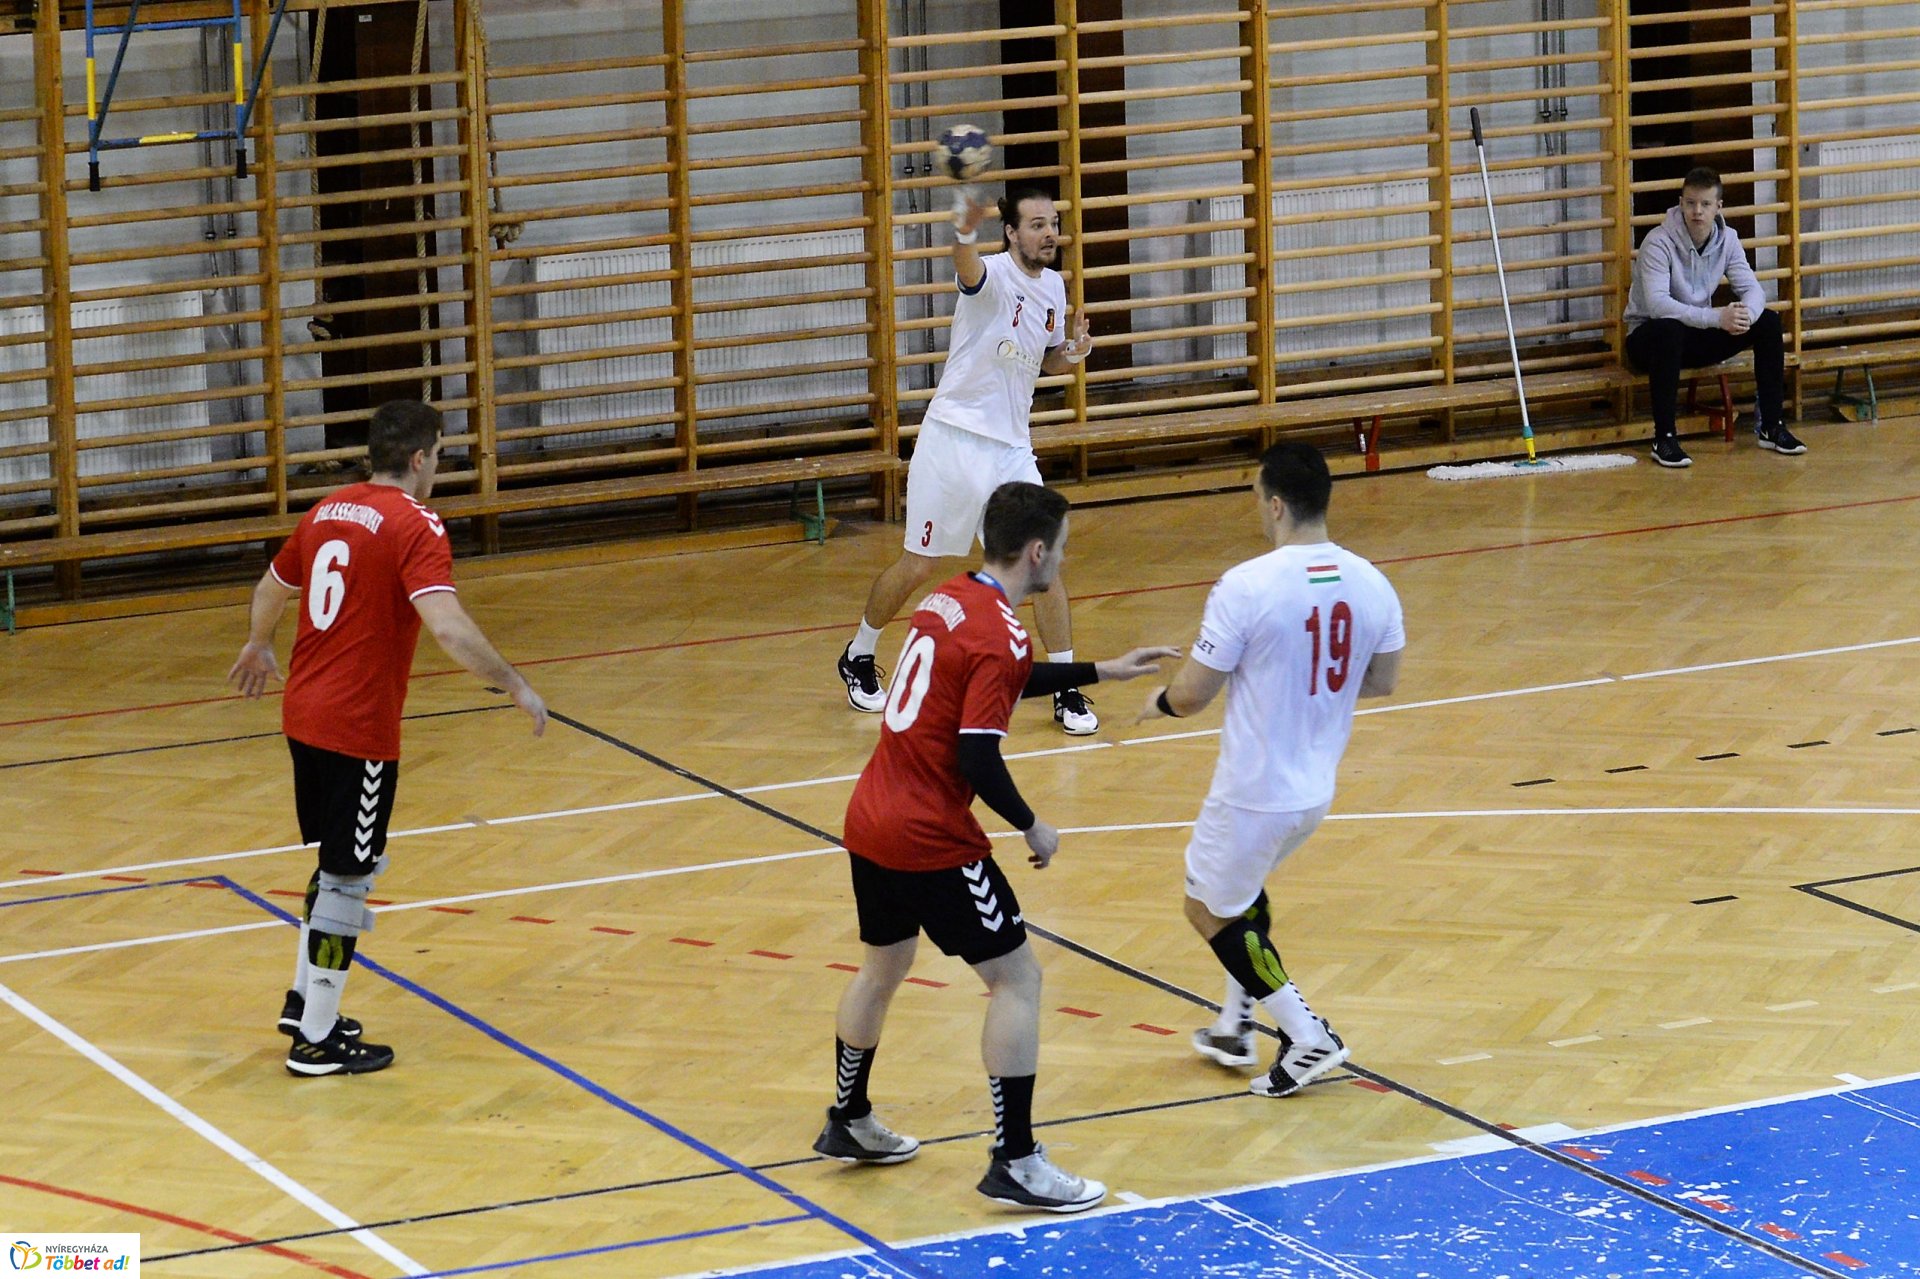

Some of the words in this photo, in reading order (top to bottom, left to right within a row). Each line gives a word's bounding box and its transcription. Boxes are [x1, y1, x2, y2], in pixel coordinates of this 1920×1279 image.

[921, 520, 933, 547] 3
[308, 539, 349, 631] 6
[1304, 601, 1352, 696] 19
